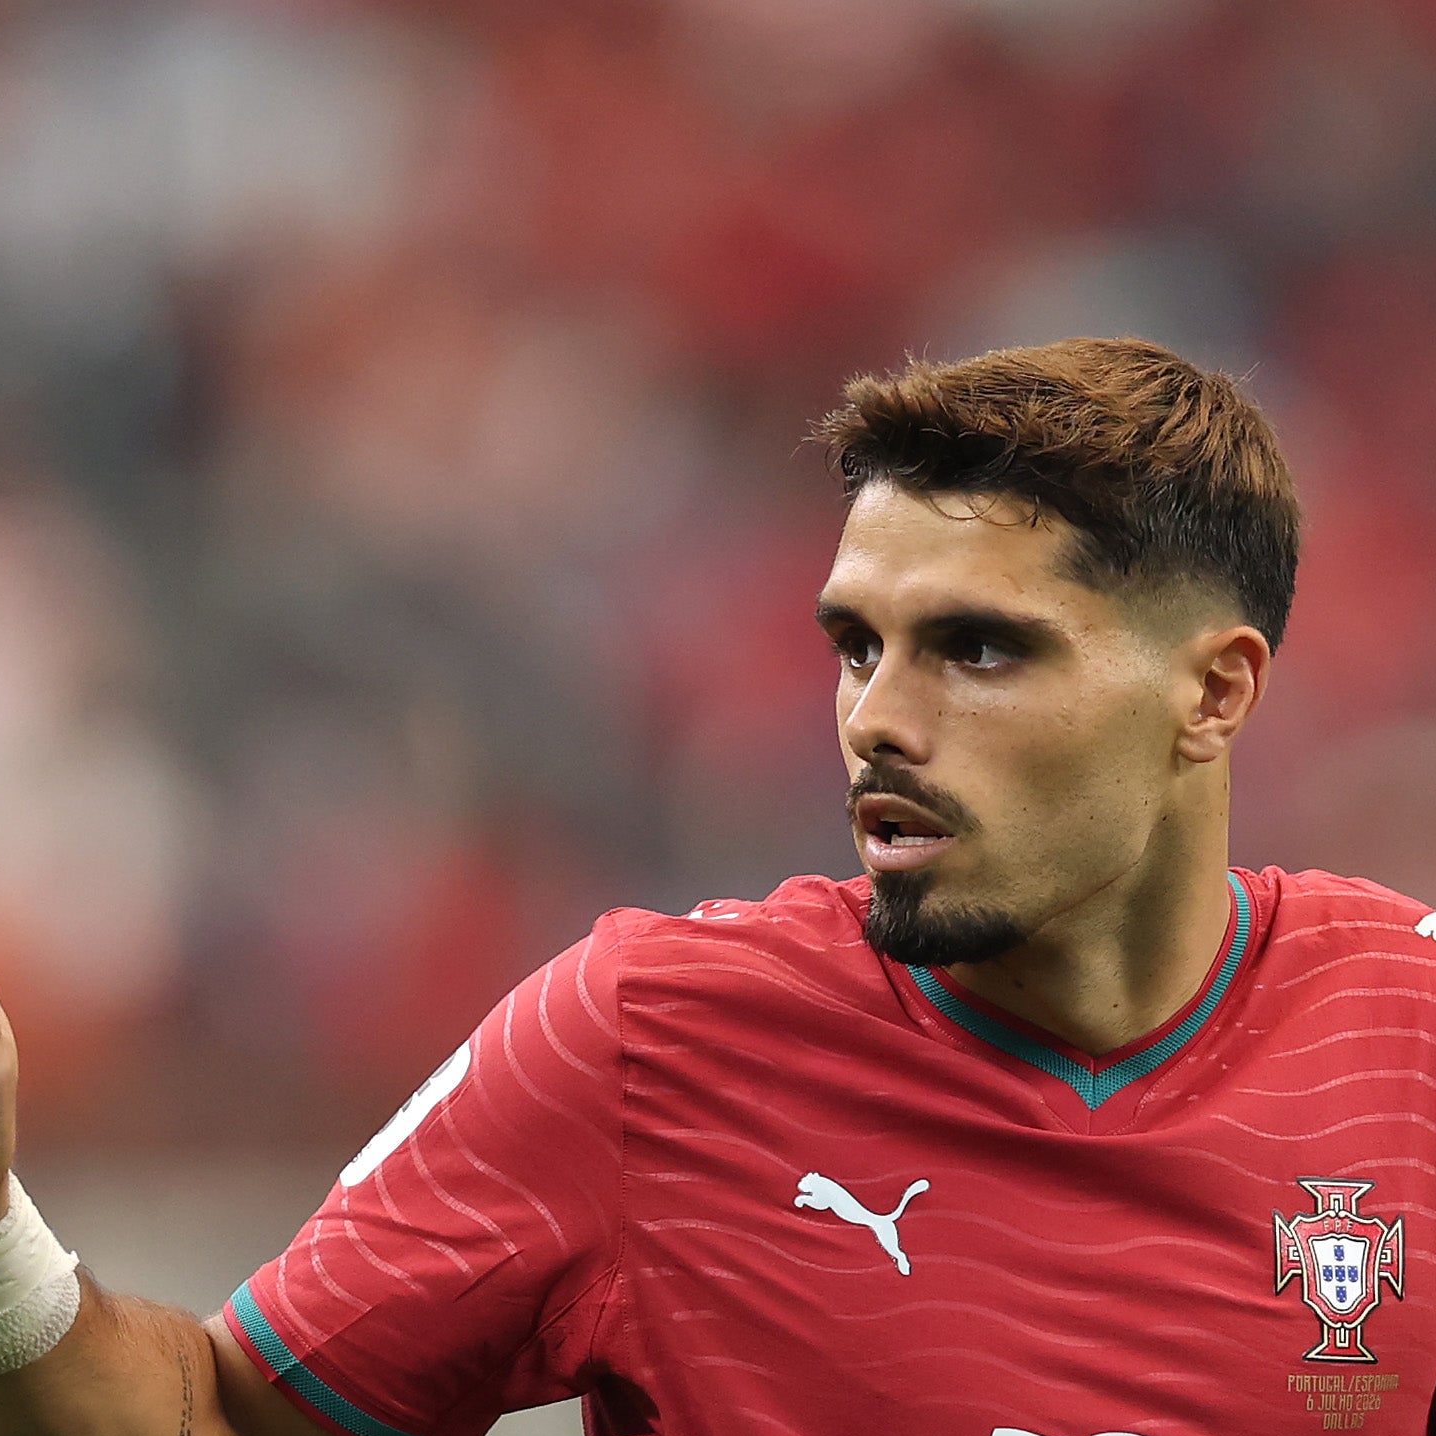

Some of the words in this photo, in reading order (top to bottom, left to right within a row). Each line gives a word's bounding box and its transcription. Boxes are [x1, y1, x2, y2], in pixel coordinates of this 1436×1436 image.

[1306, 1394, 1314, 1411] 6
[1318, 1394, 1353, 1411] JULHO
[1323, 1412, 1365, 1430] DALLAS
